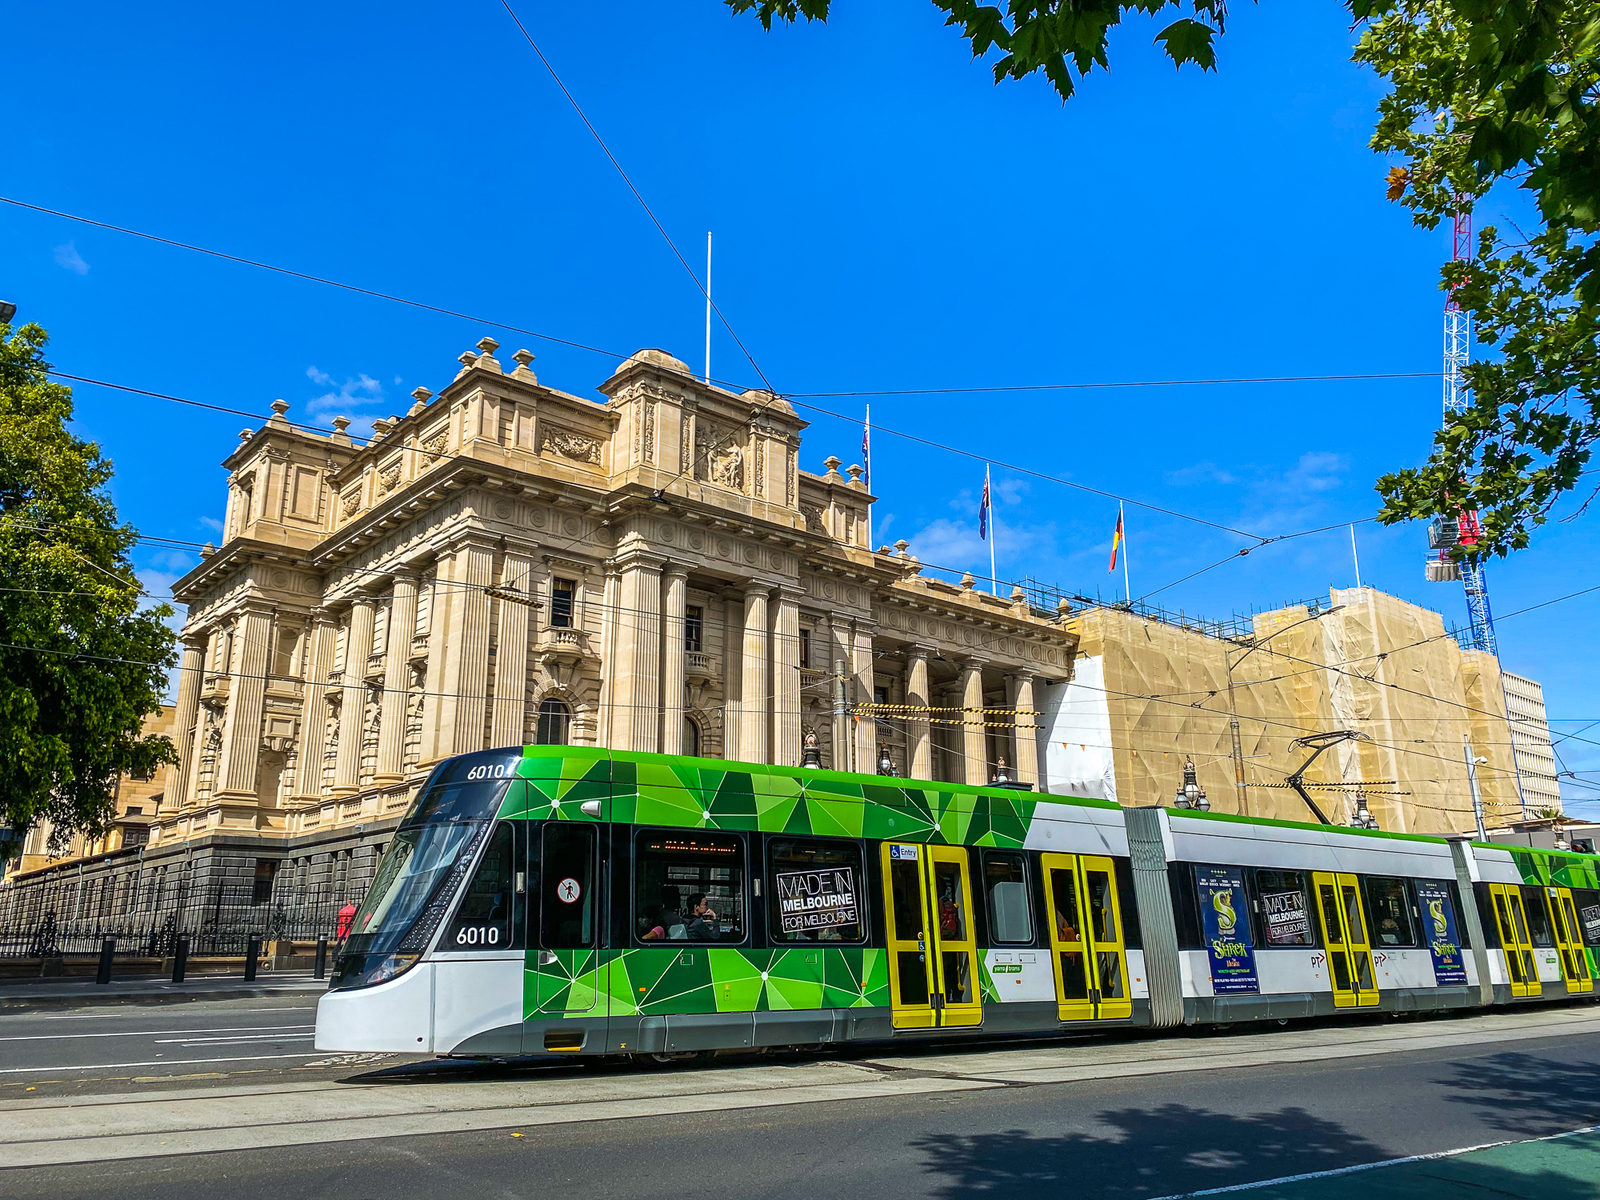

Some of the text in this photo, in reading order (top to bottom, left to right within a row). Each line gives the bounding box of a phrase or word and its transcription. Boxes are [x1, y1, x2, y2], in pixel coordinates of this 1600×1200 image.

[467, 764, 505, 780] 6010
[901, 848, 917, 858] Entry
[780, 871, 851, 899] MADE IN
[783, 893, 853, 912] MELBOURNE
[1265, 895, 1293, 913] MADE
[784, 910, 855, 929] FOR MELBOURNE
[1269, 909, 1305, 923] MELBOURNE
[456, 927, 499, 945] 6010
